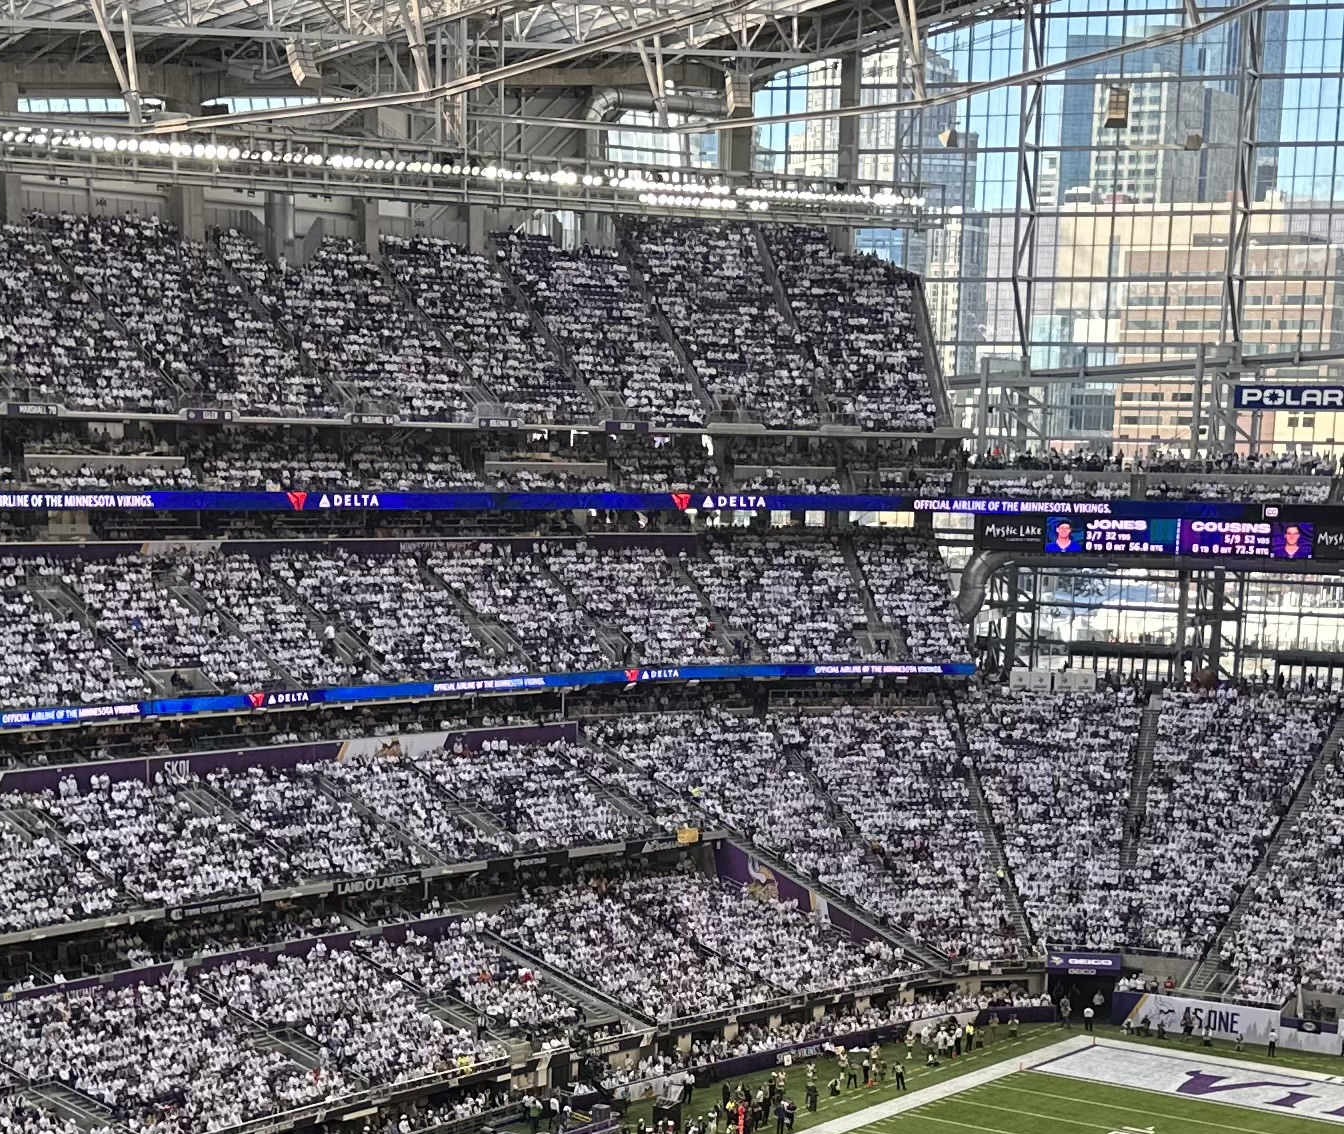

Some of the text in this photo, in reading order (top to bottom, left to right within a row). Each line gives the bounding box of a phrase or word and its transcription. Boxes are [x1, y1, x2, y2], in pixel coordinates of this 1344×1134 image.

[31, 494, 43, 507] OF
[45, 494, 62, 507] THE
[64, 494, 116, 508] MINNESOTA
[117, 494, 154, 508] VIKINGS.
[333, 494, 379, 507] DELTA
[717, 495, 766, 507] DELTA
[914, 499, 1112, 514] OFFICIAL AIRLINE OF THE MINNESOTA VIKINGS.
[1086, 519, 1148, 530] JONES
[1191, 521, 1272, 534] COUSINS
[1086, 531, 1117, 541] 3/7 32
[1224, 534, 1256, 544] 5/9 52
[650, 669, 679, 679] DELTA
[277, 692, 309, 704] DELTA
[337, 881, 365, 895] LAND
[1068, 967, 1097, 976] GEICO
[1208, 1009, 1240, 1034] ONE
